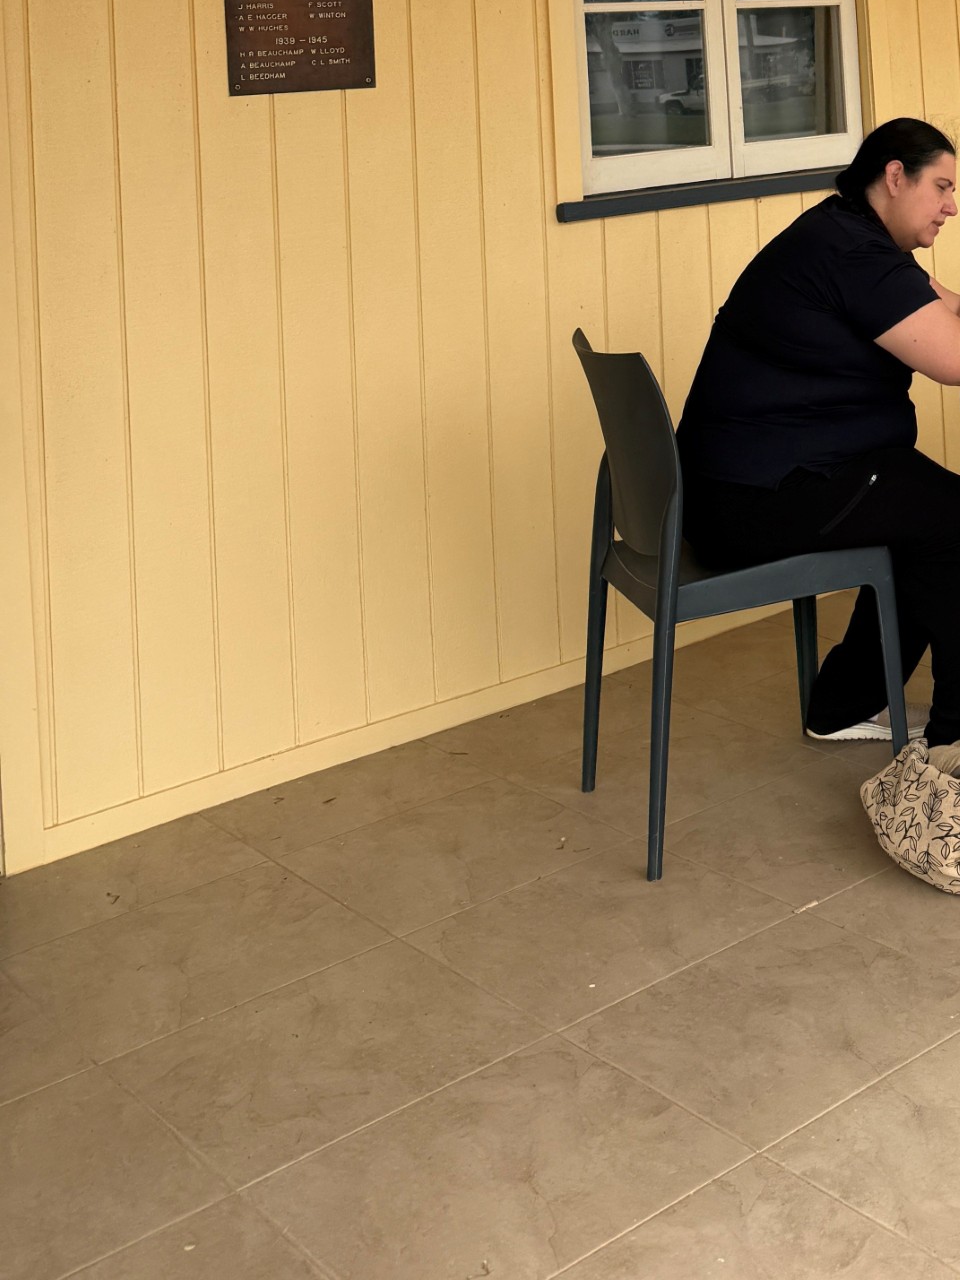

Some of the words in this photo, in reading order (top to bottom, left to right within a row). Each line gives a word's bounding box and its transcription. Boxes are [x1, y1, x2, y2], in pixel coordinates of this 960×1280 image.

[246, 2, 274, 10] HARRIS
[318, 11, 346, 19] WINTON
[275, 36, 296, 45] 1939
[308, 35, 328, 44] 1945
[257, 48, 304, 57] BEAUCHAMP
[319, 47, 345, 55] LLOYD
[249, 60, 296, 69] BEAUCHAMP
[328, 57, 351, 65] SMITH
[249, 72, 286, 81] BEEDHAM
